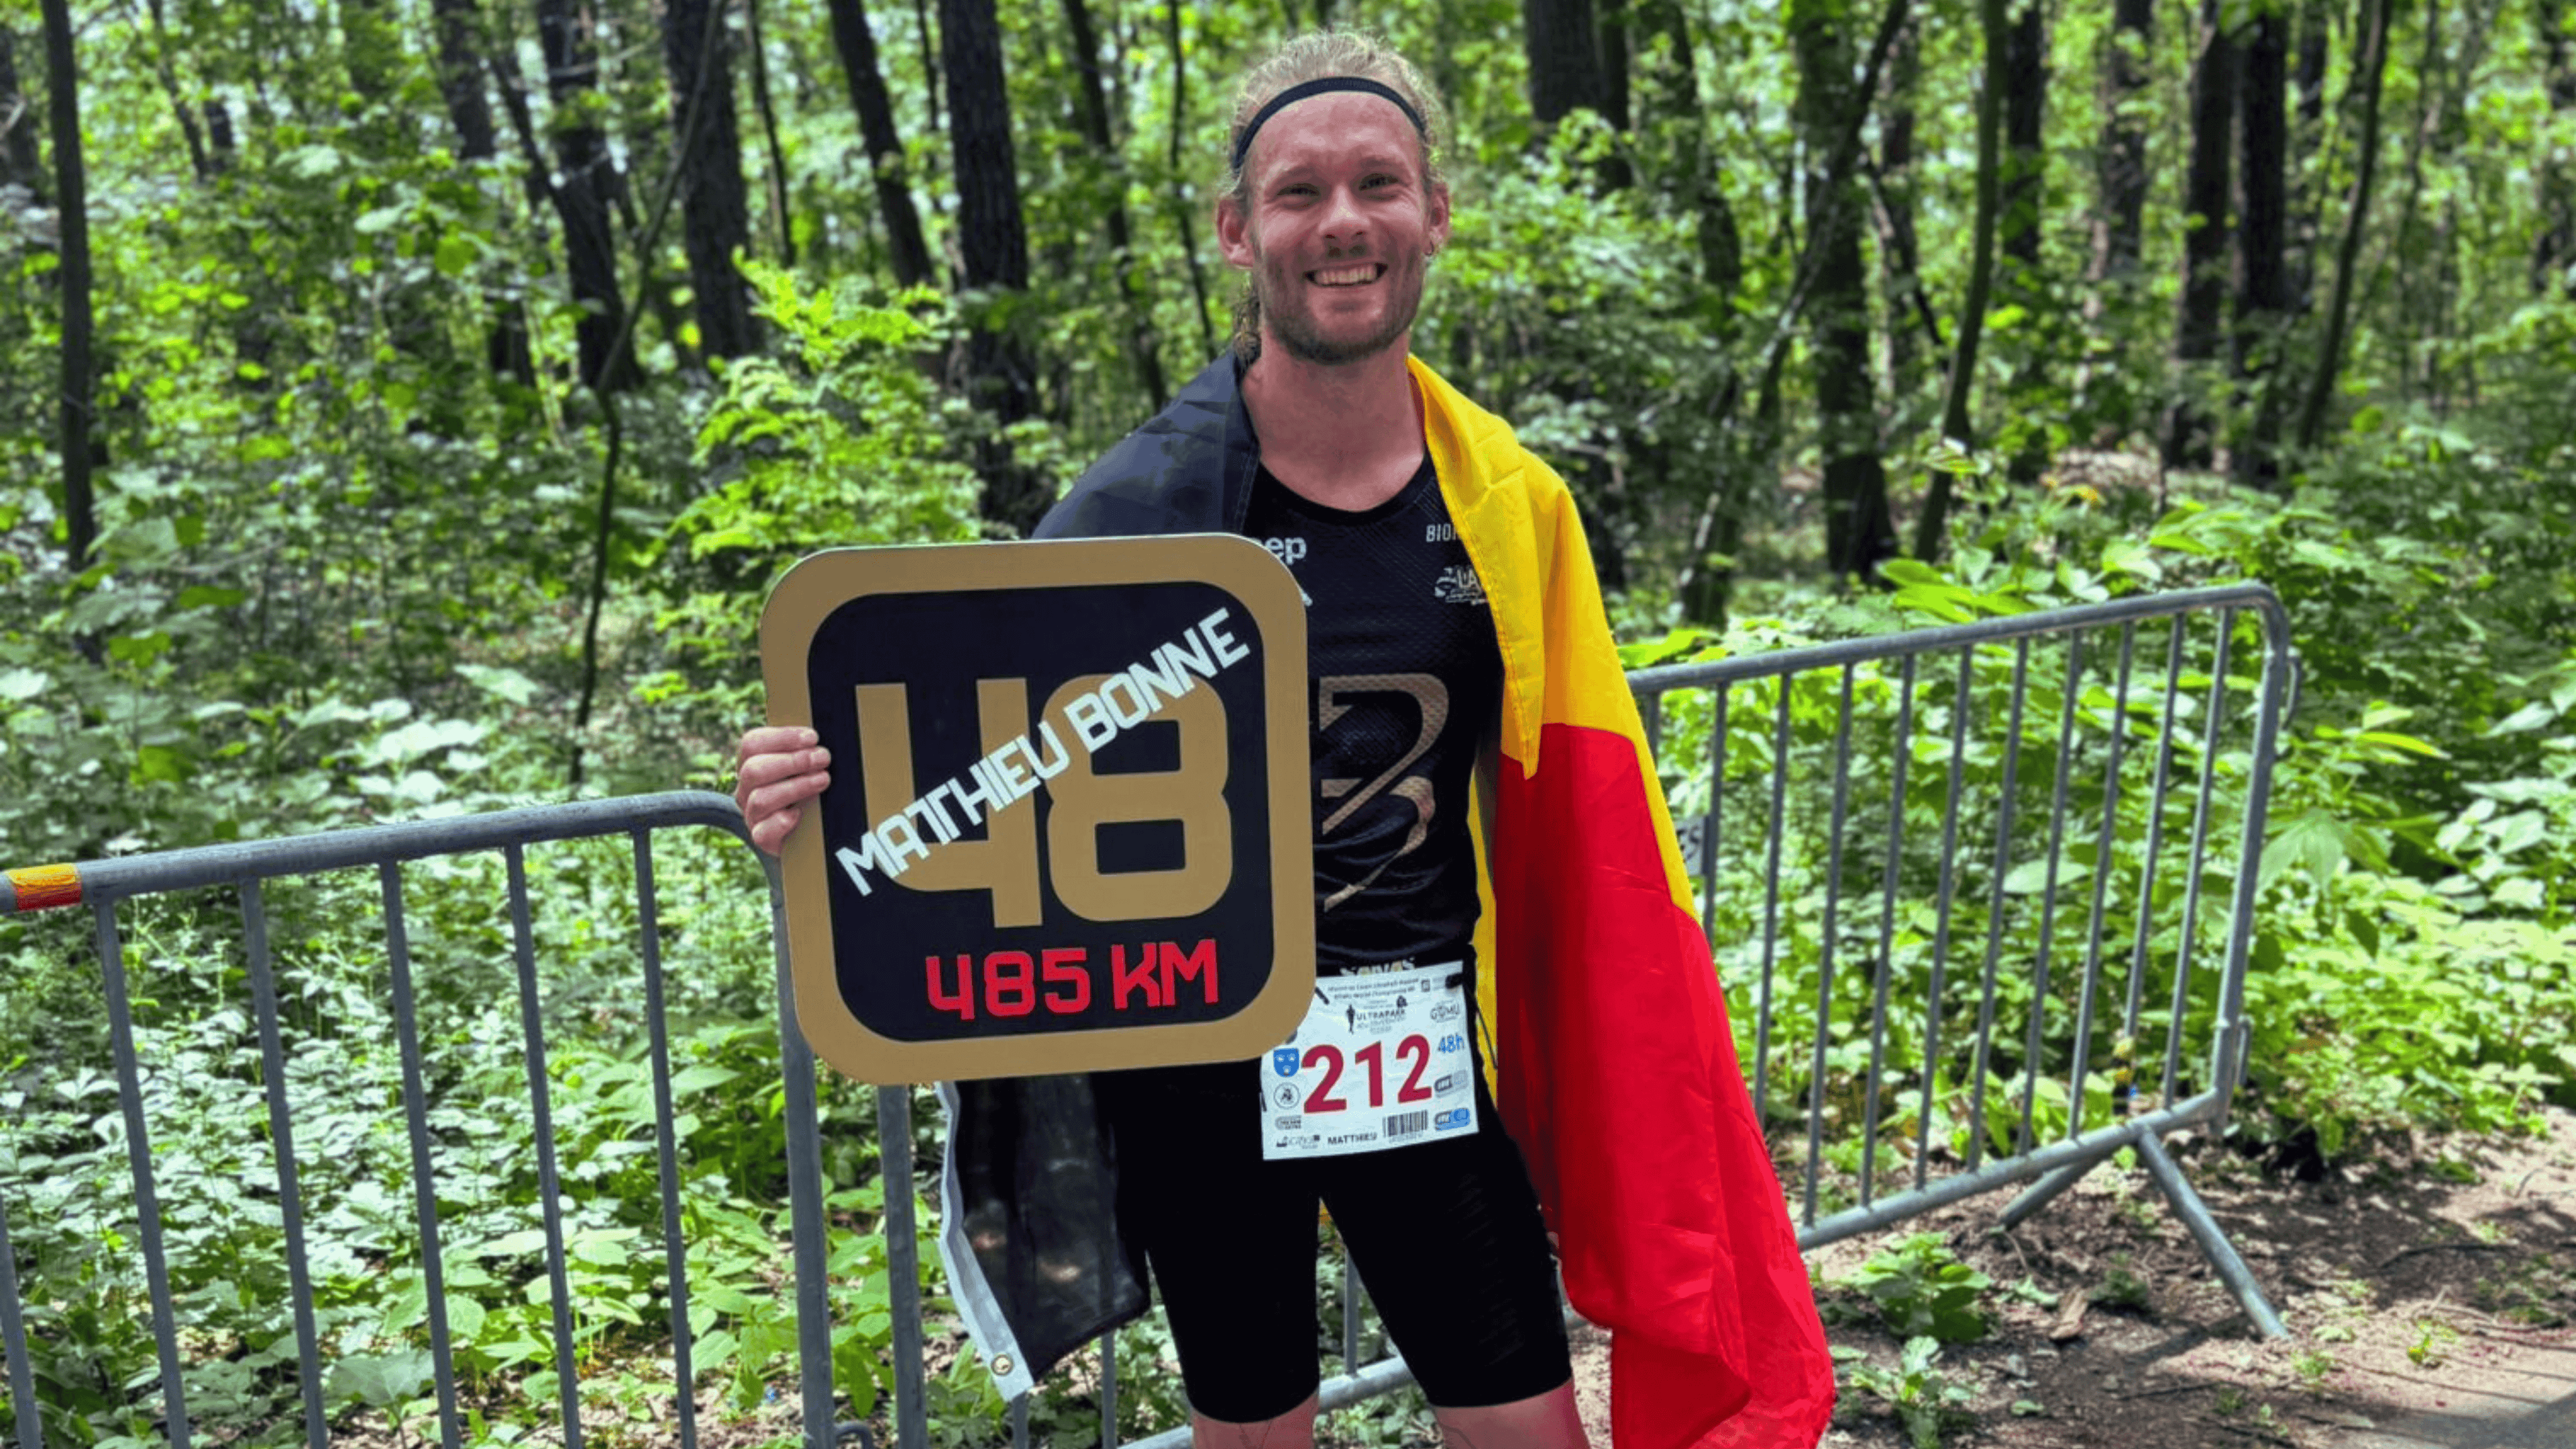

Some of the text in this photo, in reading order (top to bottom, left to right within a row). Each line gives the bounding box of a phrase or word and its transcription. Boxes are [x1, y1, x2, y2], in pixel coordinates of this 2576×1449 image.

[835, 607, 1251, 897] MATTHIEU BONNE
[855, 674, 1234, 928] 48
[925, 938, 1220, 1021] 485 KM
[1301, 1033, 1433, 1114] 212
